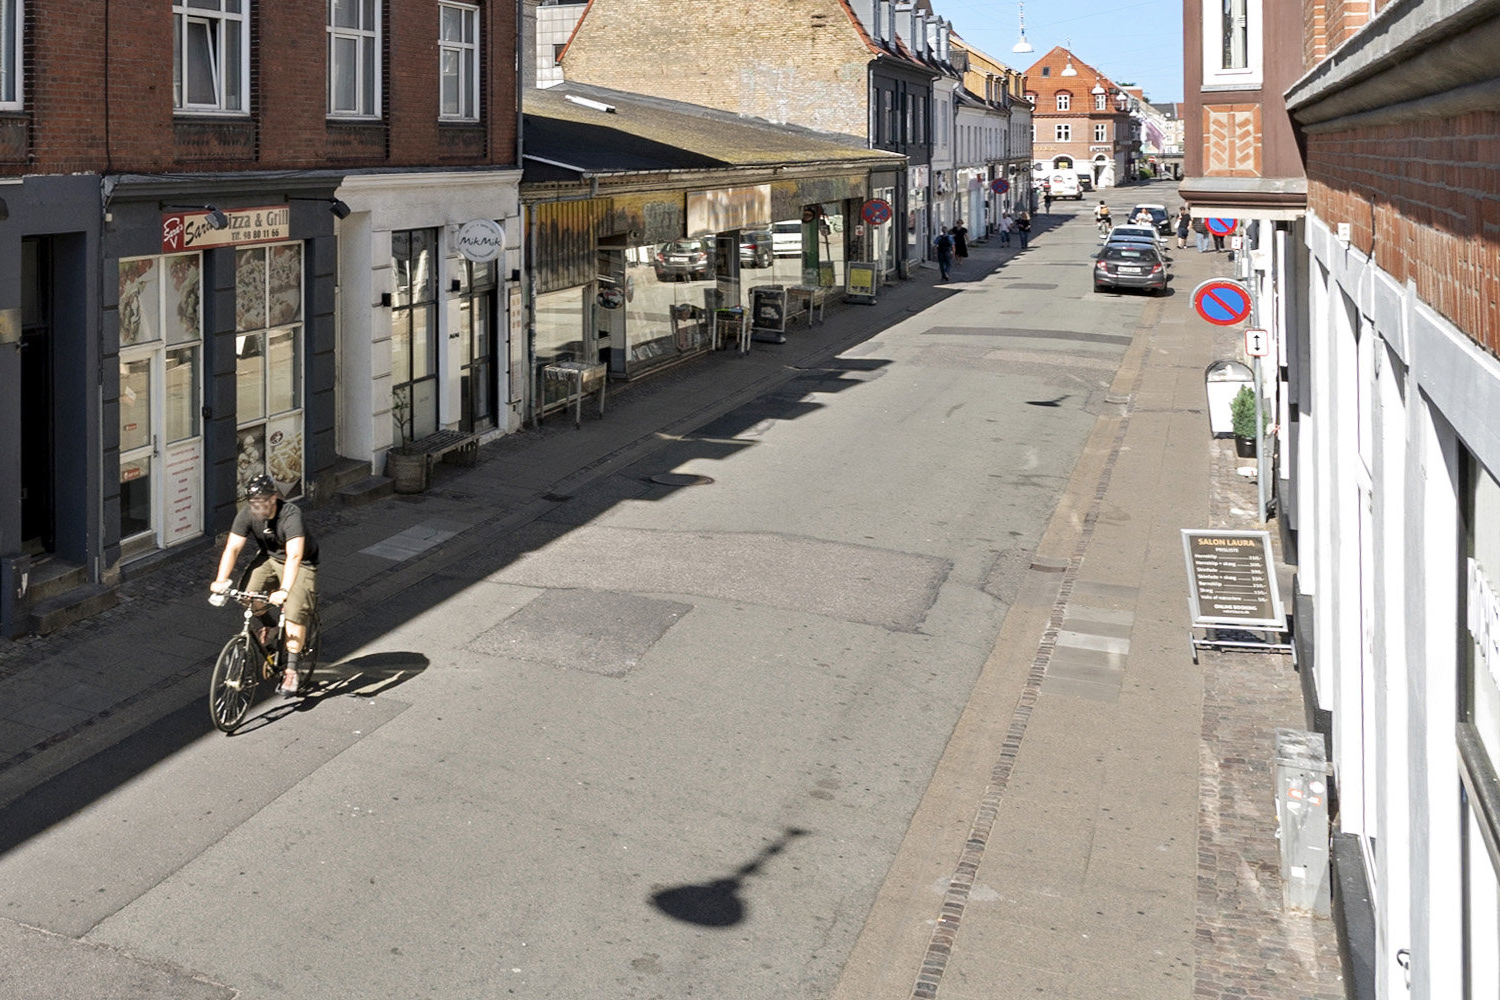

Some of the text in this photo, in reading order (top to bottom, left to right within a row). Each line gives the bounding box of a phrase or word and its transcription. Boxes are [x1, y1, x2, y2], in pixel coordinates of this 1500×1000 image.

[227, 213, 250, 230] izza
[254, 213, 263, 227] &
[267, 209, 289, 227] Grill
[1198, 538, 1255, 547] SALON LAURA
